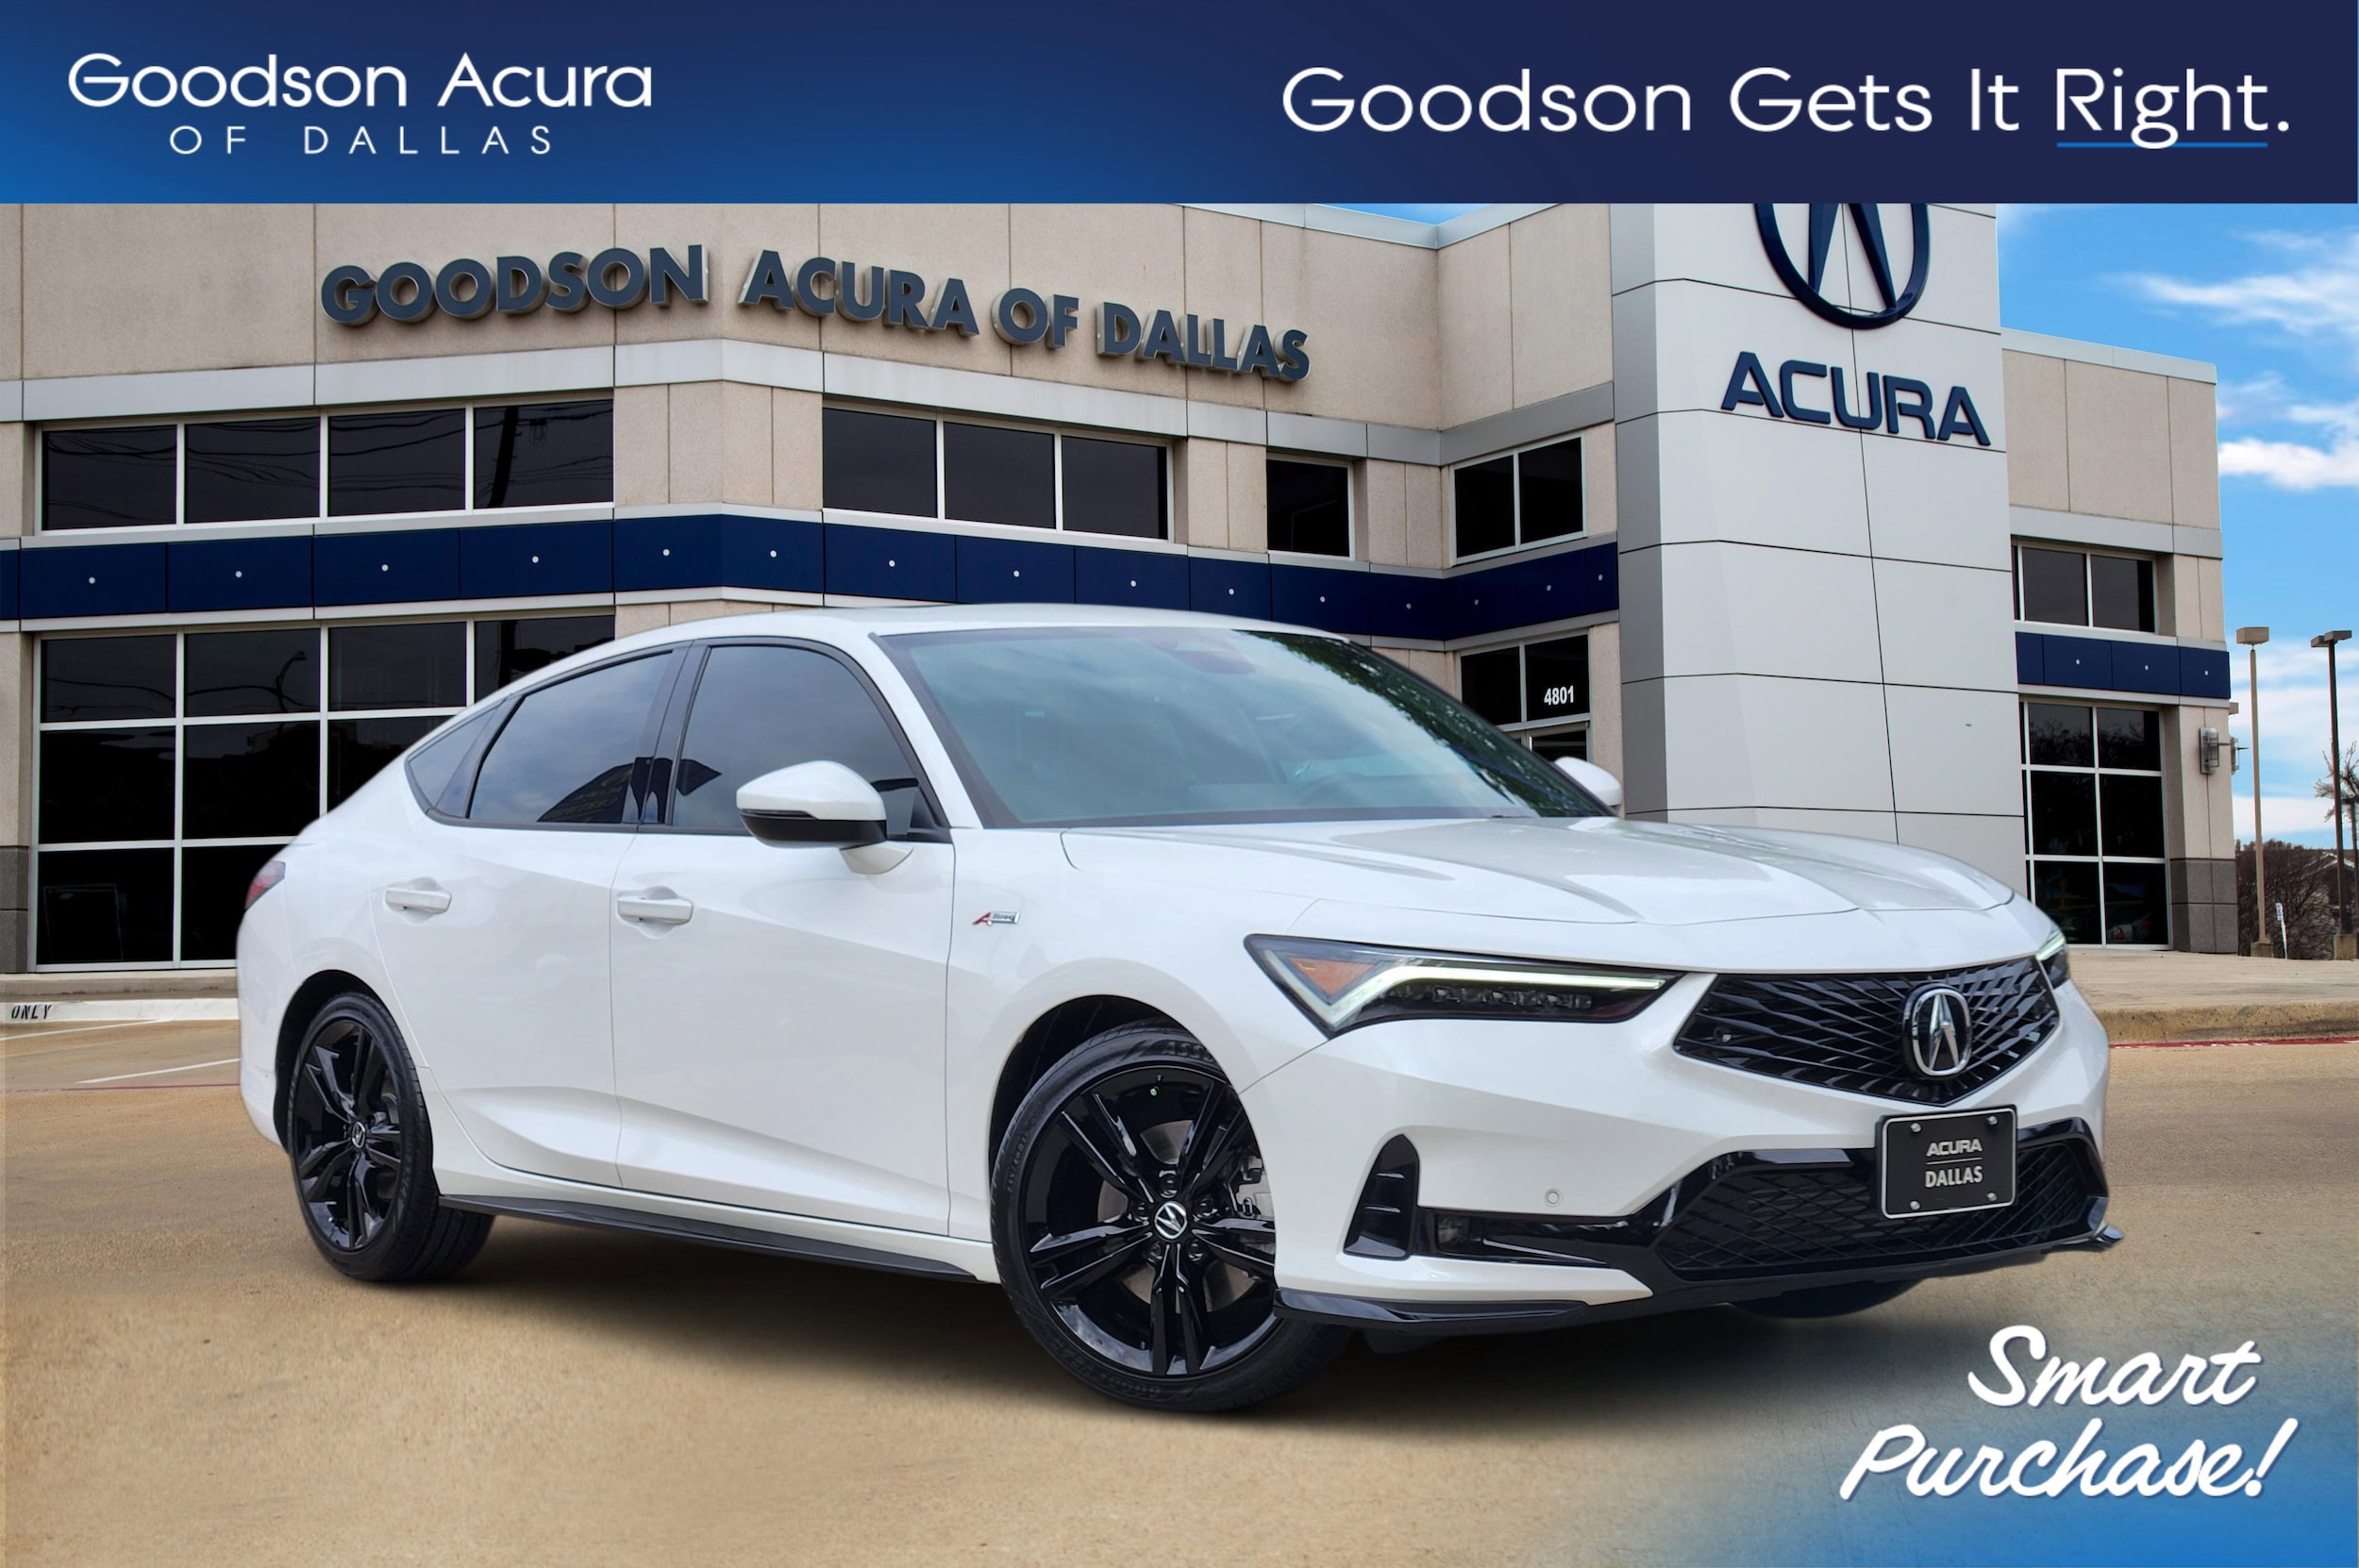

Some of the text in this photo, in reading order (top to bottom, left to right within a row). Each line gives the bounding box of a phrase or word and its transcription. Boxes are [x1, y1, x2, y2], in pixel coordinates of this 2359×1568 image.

[321, 244, 1310, 380] GOODSON ACURA OF DALLAS
[1721, 351, 1991, 446] ACURA
[1544, 685, 1574, 706] 4801
[11, 1004, 52, 1020] ONLY
[1926, 1138, 1983, 1158] ACURA
[1925, 1165, 1983, 1189] DALLAS
